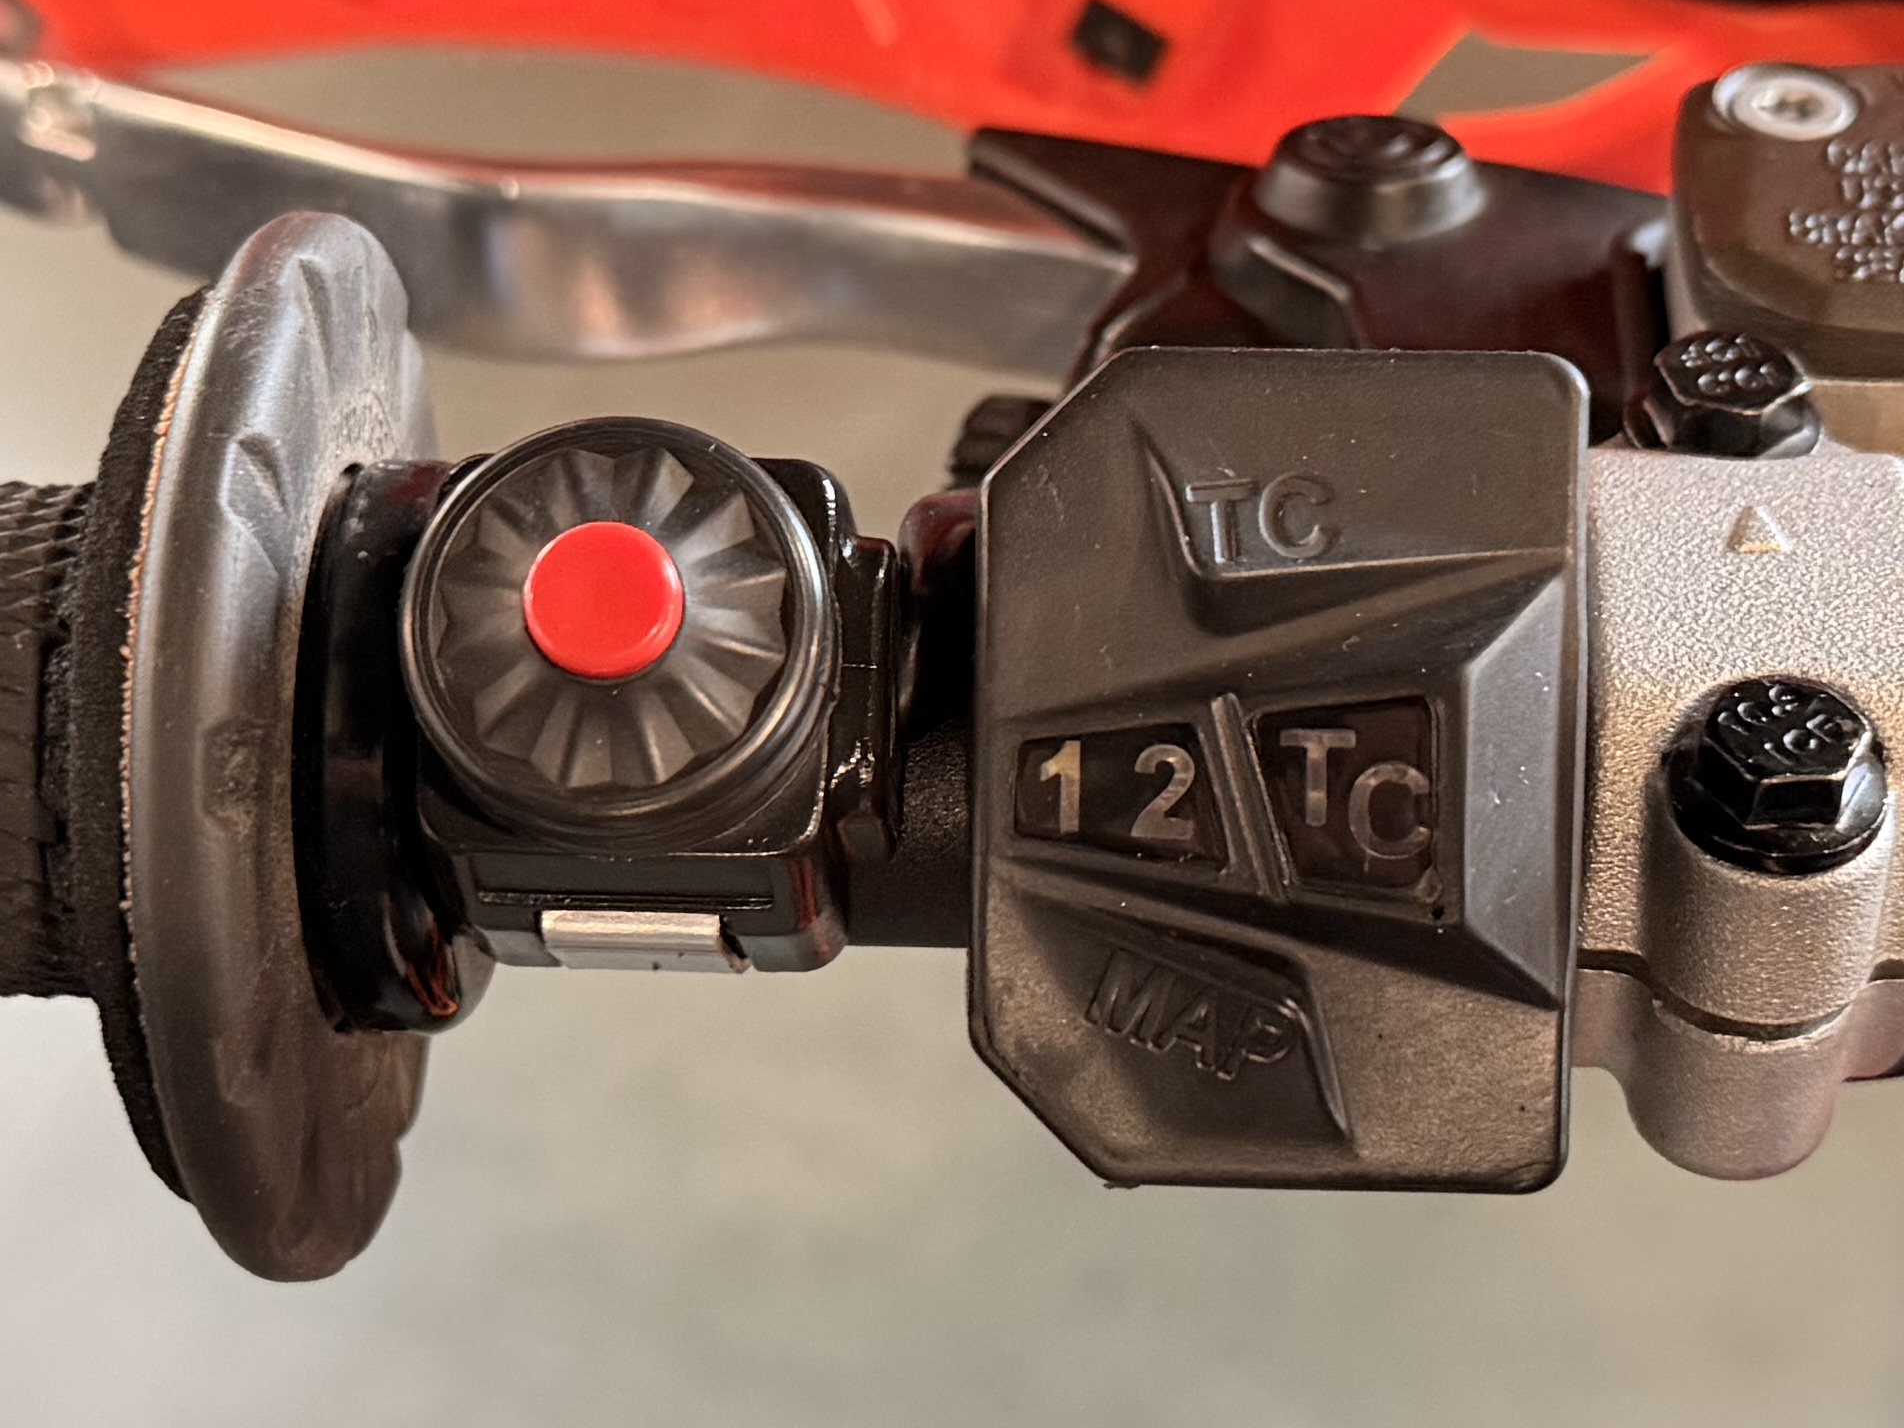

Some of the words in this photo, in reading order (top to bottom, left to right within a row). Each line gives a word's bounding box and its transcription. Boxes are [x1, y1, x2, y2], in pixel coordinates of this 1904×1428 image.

[1183, 474, 1342, 565] TC
[1036, 738, 1084, 834] 1
[1129, 742, 1198, 841] 2
[1278, 727, 1436, 861] TC
[1086, 950, 1296, 1080] MAP
